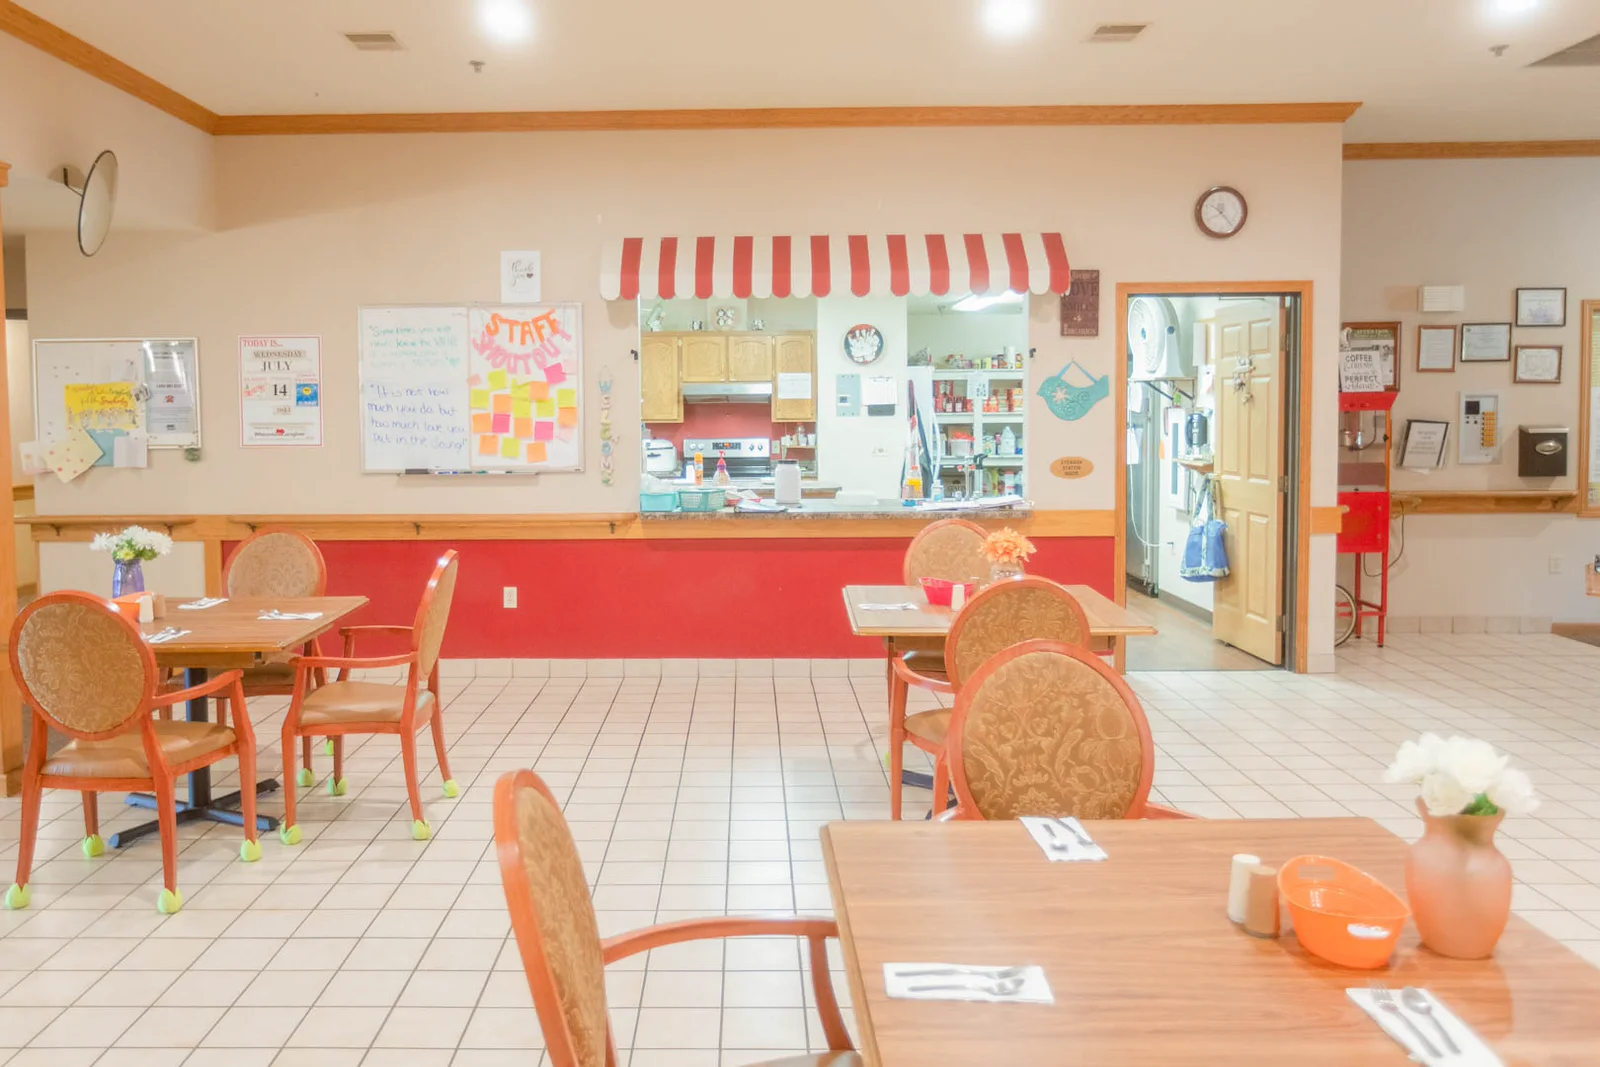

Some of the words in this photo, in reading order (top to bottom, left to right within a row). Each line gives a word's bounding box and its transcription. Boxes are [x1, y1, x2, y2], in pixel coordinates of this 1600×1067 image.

[1069, 281, 1099, 296] OVE
[484, 308, 556, 346] STAFF
[243, 339, 267, 348] TODAY
[253, 350, 303, 359] WEDNESDAY
[1345, 354, 1373, 362] COFFEE
[261, 360, 292, 372] JULY
[1344, 375, 1378, 383] PERFECT
[273, 383, 287, 397] 14
